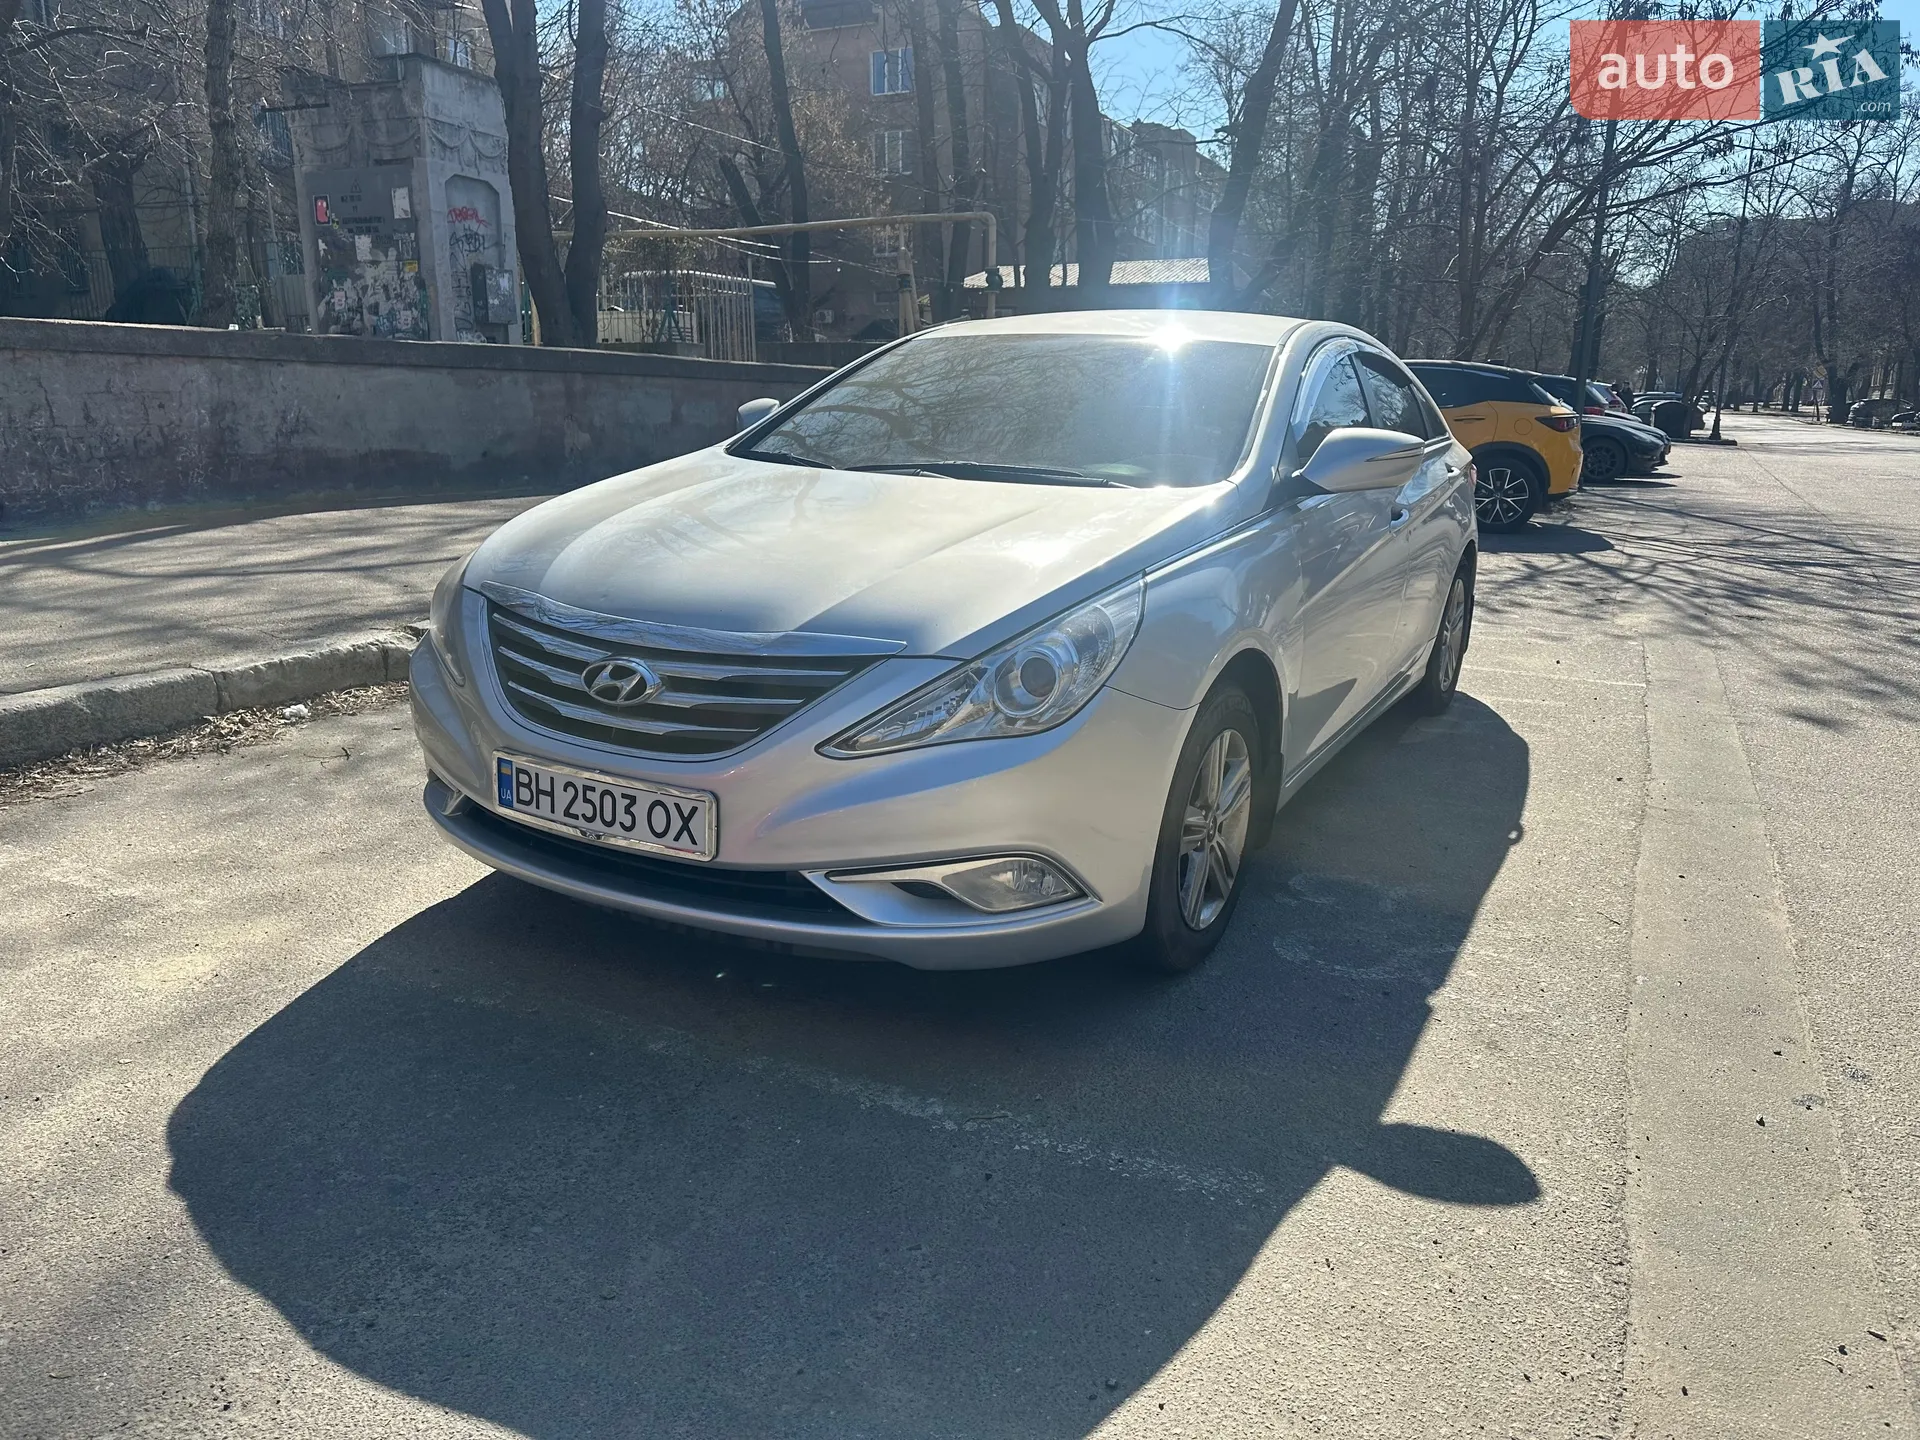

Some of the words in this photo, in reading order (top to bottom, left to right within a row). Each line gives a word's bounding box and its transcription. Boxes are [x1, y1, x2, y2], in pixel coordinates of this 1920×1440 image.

[500, 789, 512, 801] UA
[515, 767, 555, 814] BH
[563, 781, 637, 832] 2503
[647, 800, 698, 846] OX
